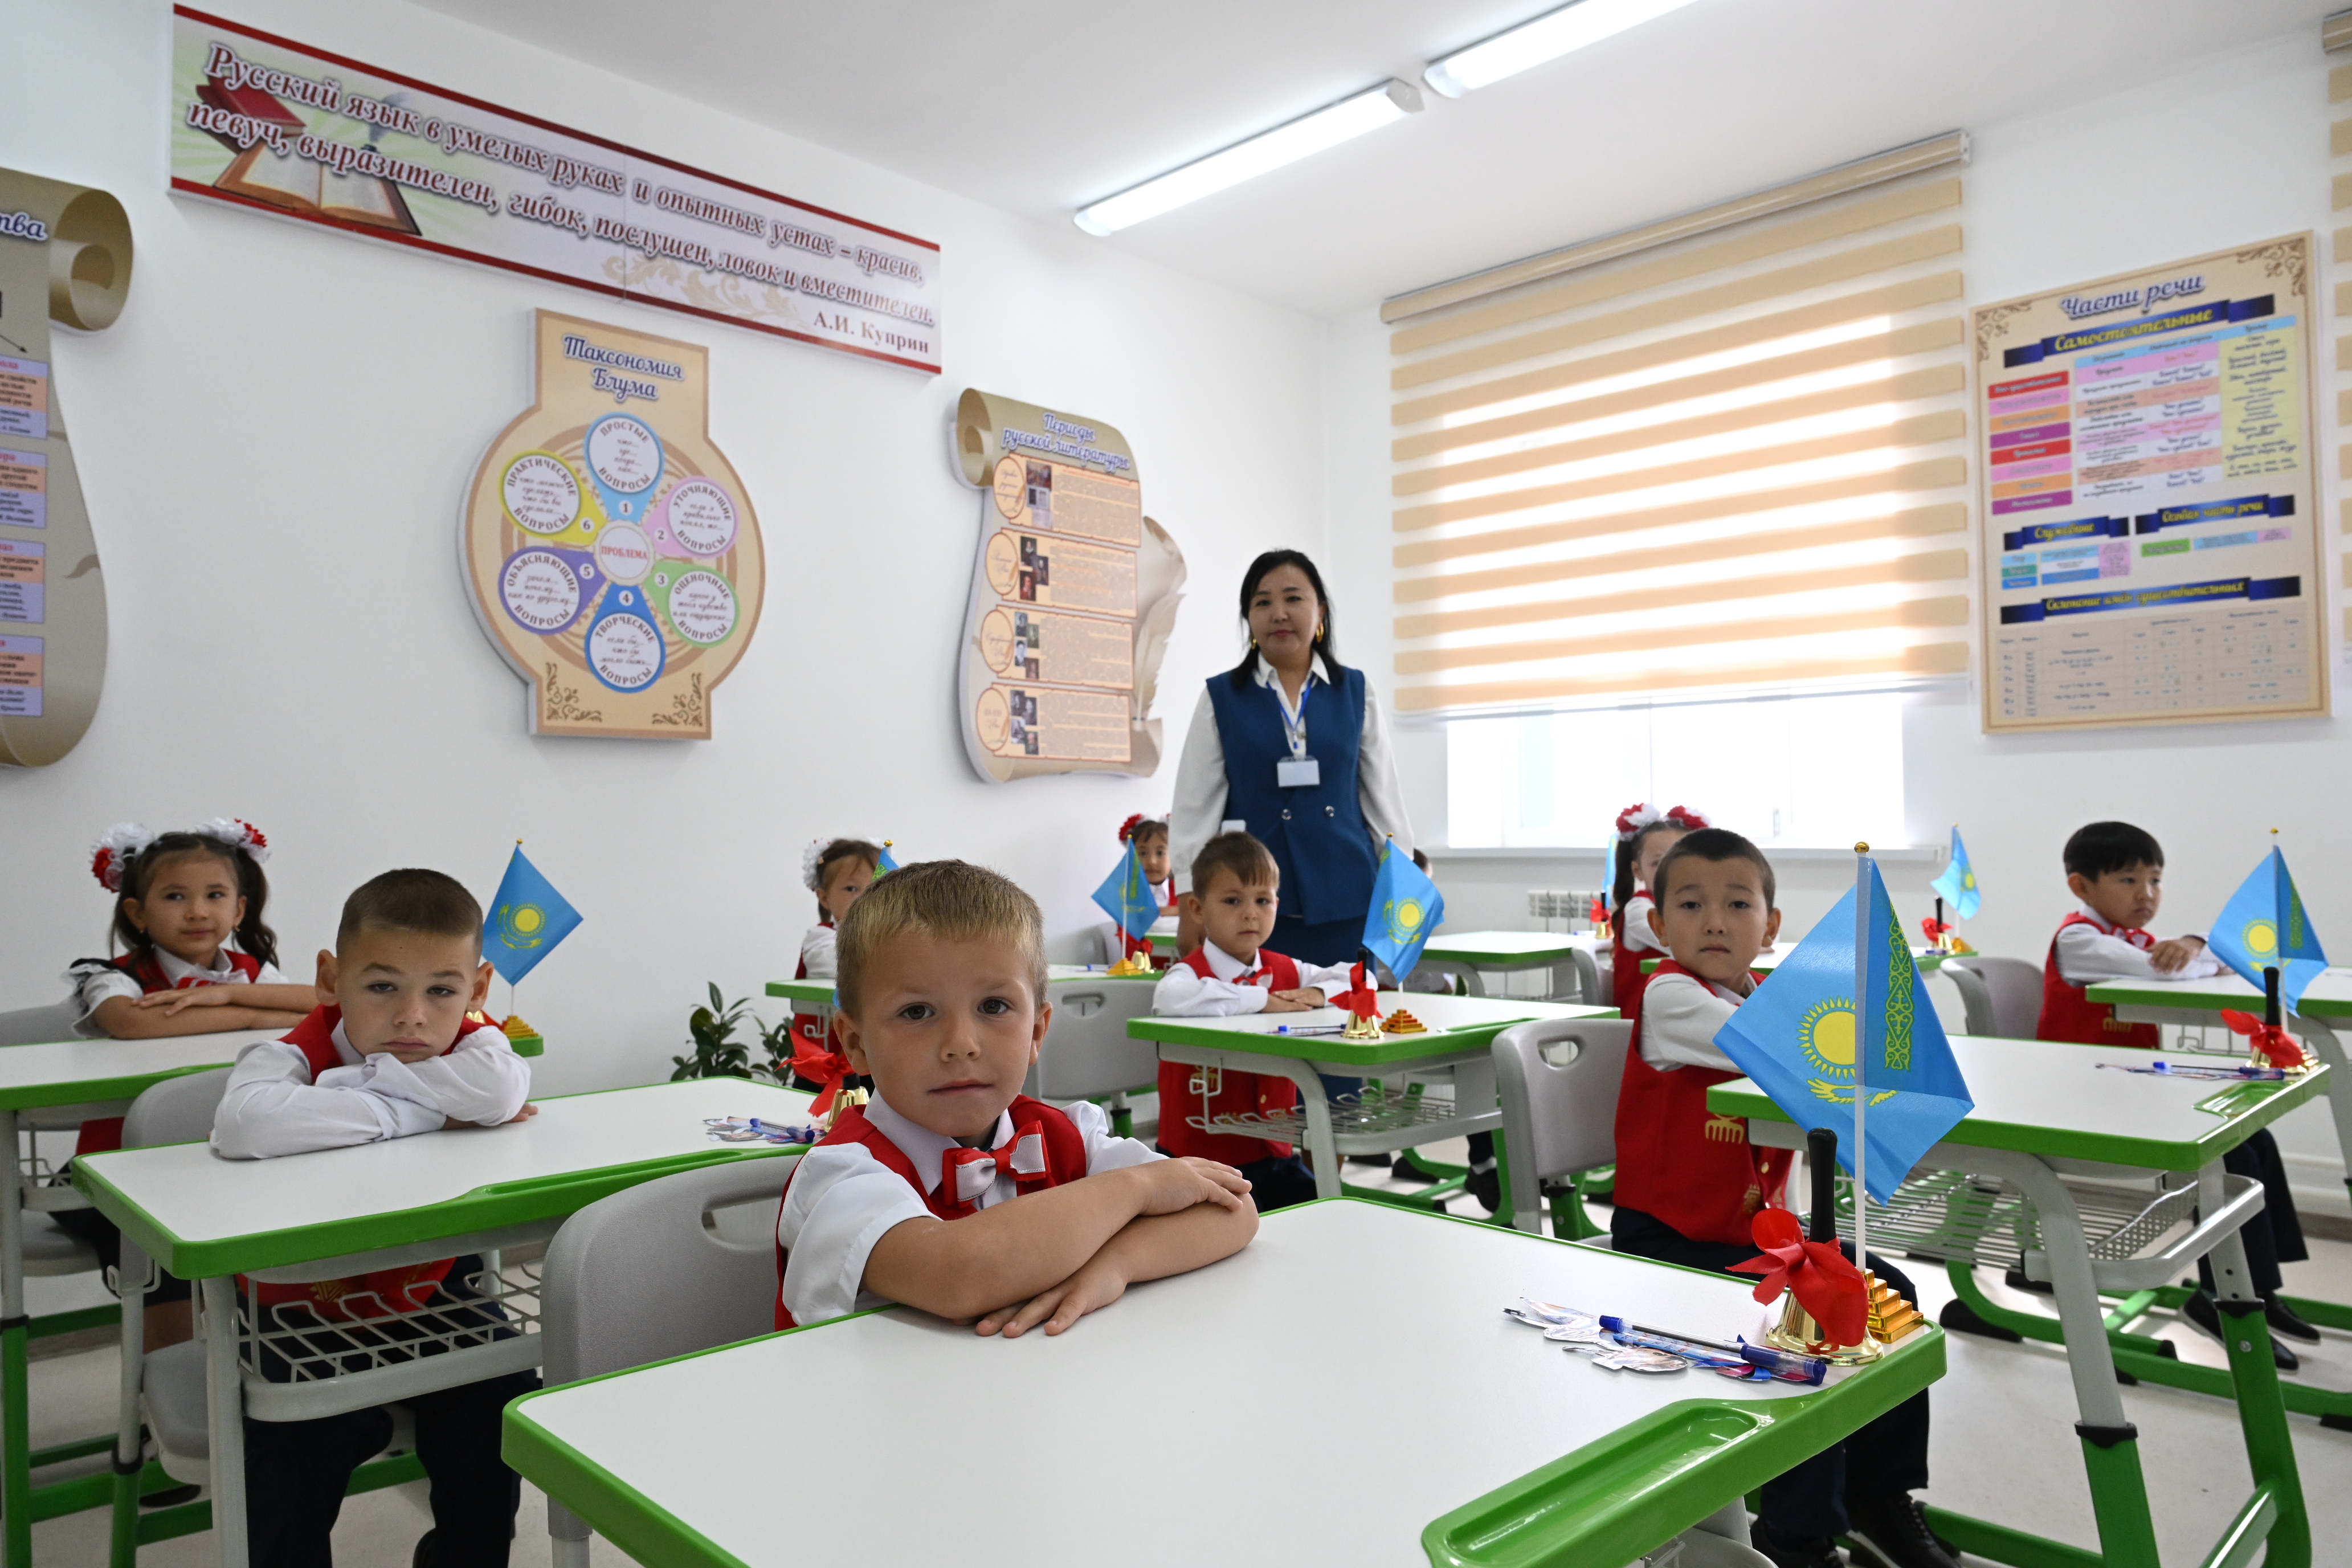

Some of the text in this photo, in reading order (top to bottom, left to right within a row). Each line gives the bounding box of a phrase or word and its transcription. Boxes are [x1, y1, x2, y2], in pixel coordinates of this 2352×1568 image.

[207, 45, 338, 109] Русский
[346, 96, 418, 134] язык
[426, 119, 442, 140] в
[444, 124, 548, 172] умелых
[551, 158, 623, 194] руках
[634, 180, 648, 202] и
[656, 185, 764, 234] опытных
[770, 222, 834, 255] устах
[855, 248, 924, 283] красив,
[187, 101, 934, 324] певуч, выразителен, гибок, послушен, ловок и вместителен.
[2061, 275, 2203, 318] Части речи
[813, 311, 929, 353] А.И. Куприн
[2055, 308, 2214, 352] Самостоятельные
[564, 336, 682, 378] Таксономия
[594, 368, 656, 399] Блума
[600, 422, 649, 443] ПРОСТЫЕ
[1044, 414, 1095, 443] Периоды
[1003, 428, 1129, 471] русской литературы
[507, 459, 577, 496] ПРАКТИЧЕСКИЕ
[599, 467, 651, 489] ВОПРОСЫ
[623, 503, 628, 513] 1
[673, 485, 732, 520] УТОЧНЯЮЩИЕ
[514, 508, 569, 530] ВОПРОСЫ
[583, 520, 590, 530] 6
[658, 529, 664, 540] 2
[677, 529, 726, 550] ВОПРОСЫ
[602, 546, 648, 560] ПРОБЛЕМА
[507, 554, 577, 593] ОБЪЯСНЯЮЩИЕ
[583, 566, 590, 577] 5
[658, 574, 665, 585] 3
[623, 593, 629, 603] 4
[674, 573, 730, 600] ОЦЕНОЧНЫЕ
[514, 604, 570, 626] ВОПРОСЫ
[595, 616, 655, 643] ТВОРЧЕСКИЕ
[678, 620, 727, 640] ВОПРОСЫ
[599, 664, 652, 685] ВОПРОСЫ
